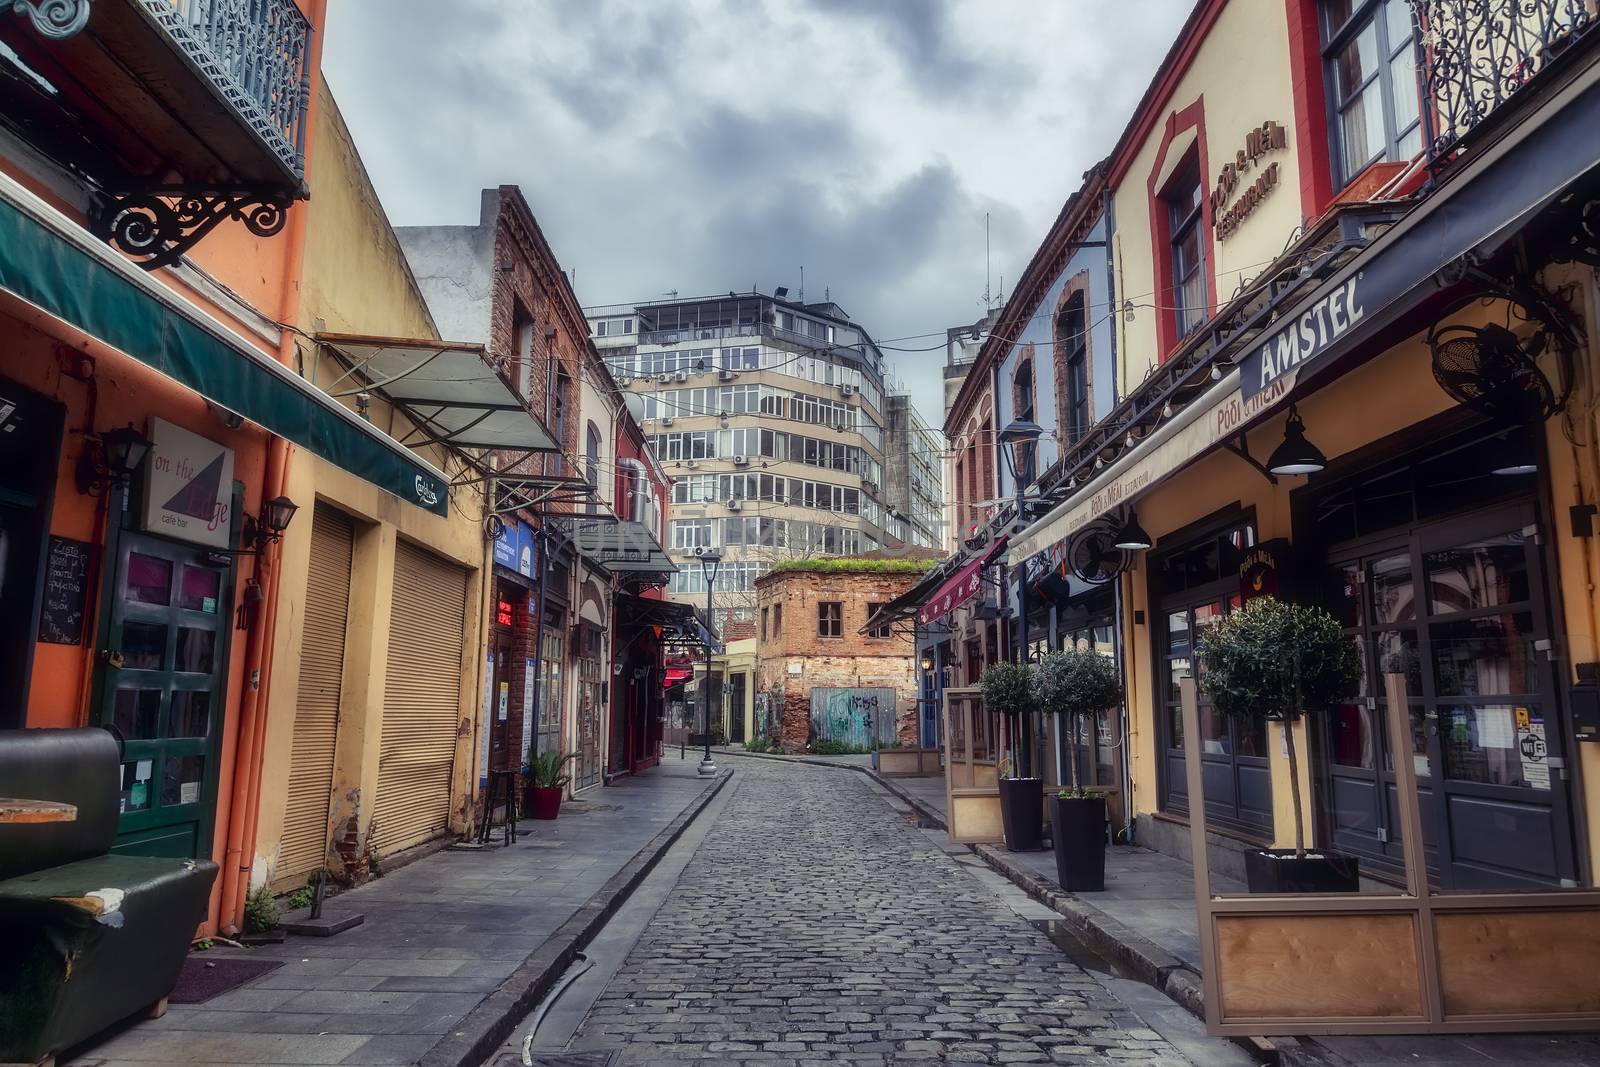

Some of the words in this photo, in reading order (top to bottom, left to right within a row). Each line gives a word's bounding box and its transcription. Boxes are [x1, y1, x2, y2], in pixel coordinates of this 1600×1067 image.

[1260, 275, 1364, 389] AMSTEL
[1216, 399, 1241, 435] Ρόδι
[155, 455, 170, 473] on
[175, 458, 194, 481] the
[415, 474, 438, 505] Carlsberg
[161, 513, 177, 525] cafe
[177, 518, 188, 528] bar
[187, 482, 228, 531] Edge
